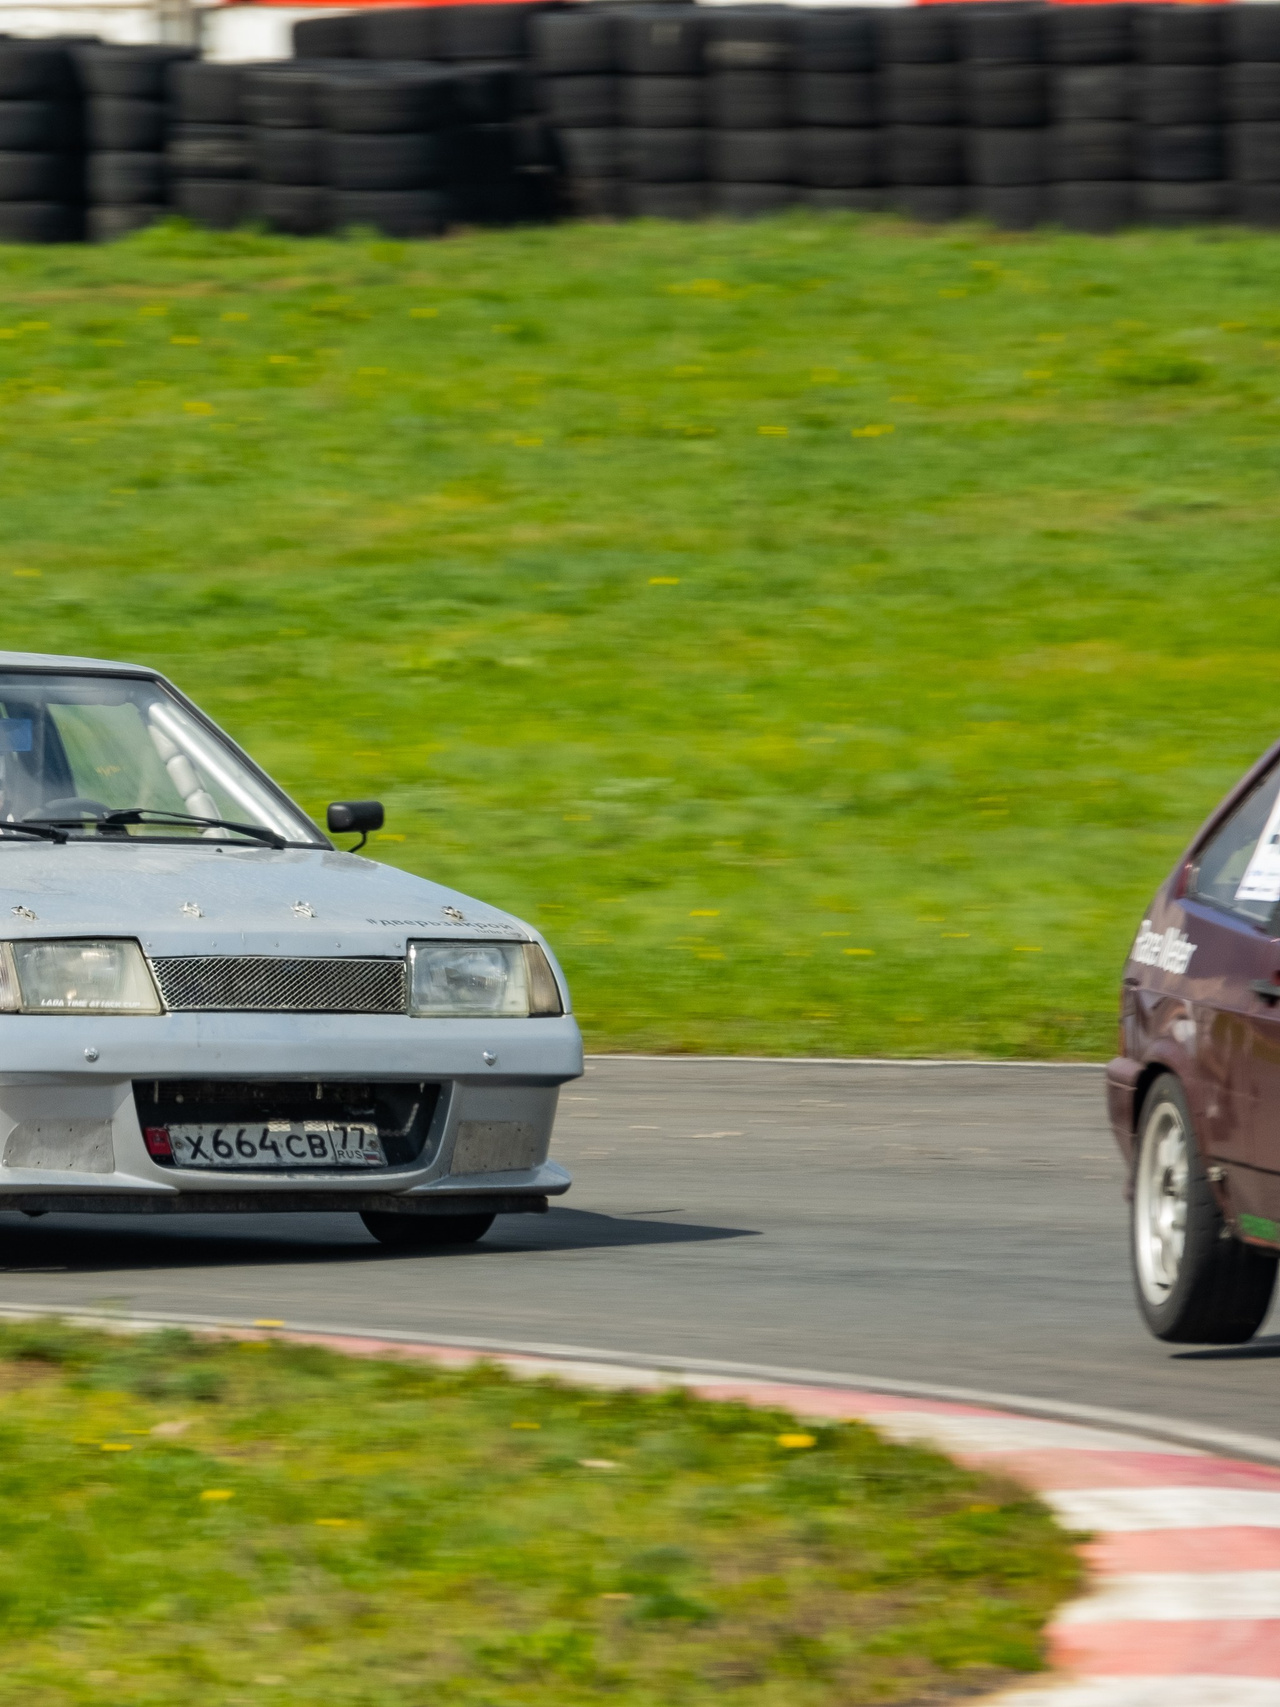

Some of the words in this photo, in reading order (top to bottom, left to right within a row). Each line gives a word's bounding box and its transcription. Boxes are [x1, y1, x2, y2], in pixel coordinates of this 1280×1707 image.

[41, 998, 64, 1007] LADA
[68, 999, 87, 1008] TIME
[89, 1000, 121, 1009] ATTACK
[123, 1001, 140, 1009] CUP
[333, 1126, 365, 1149] 77
[337, 1149, 363, 1159] RUS
